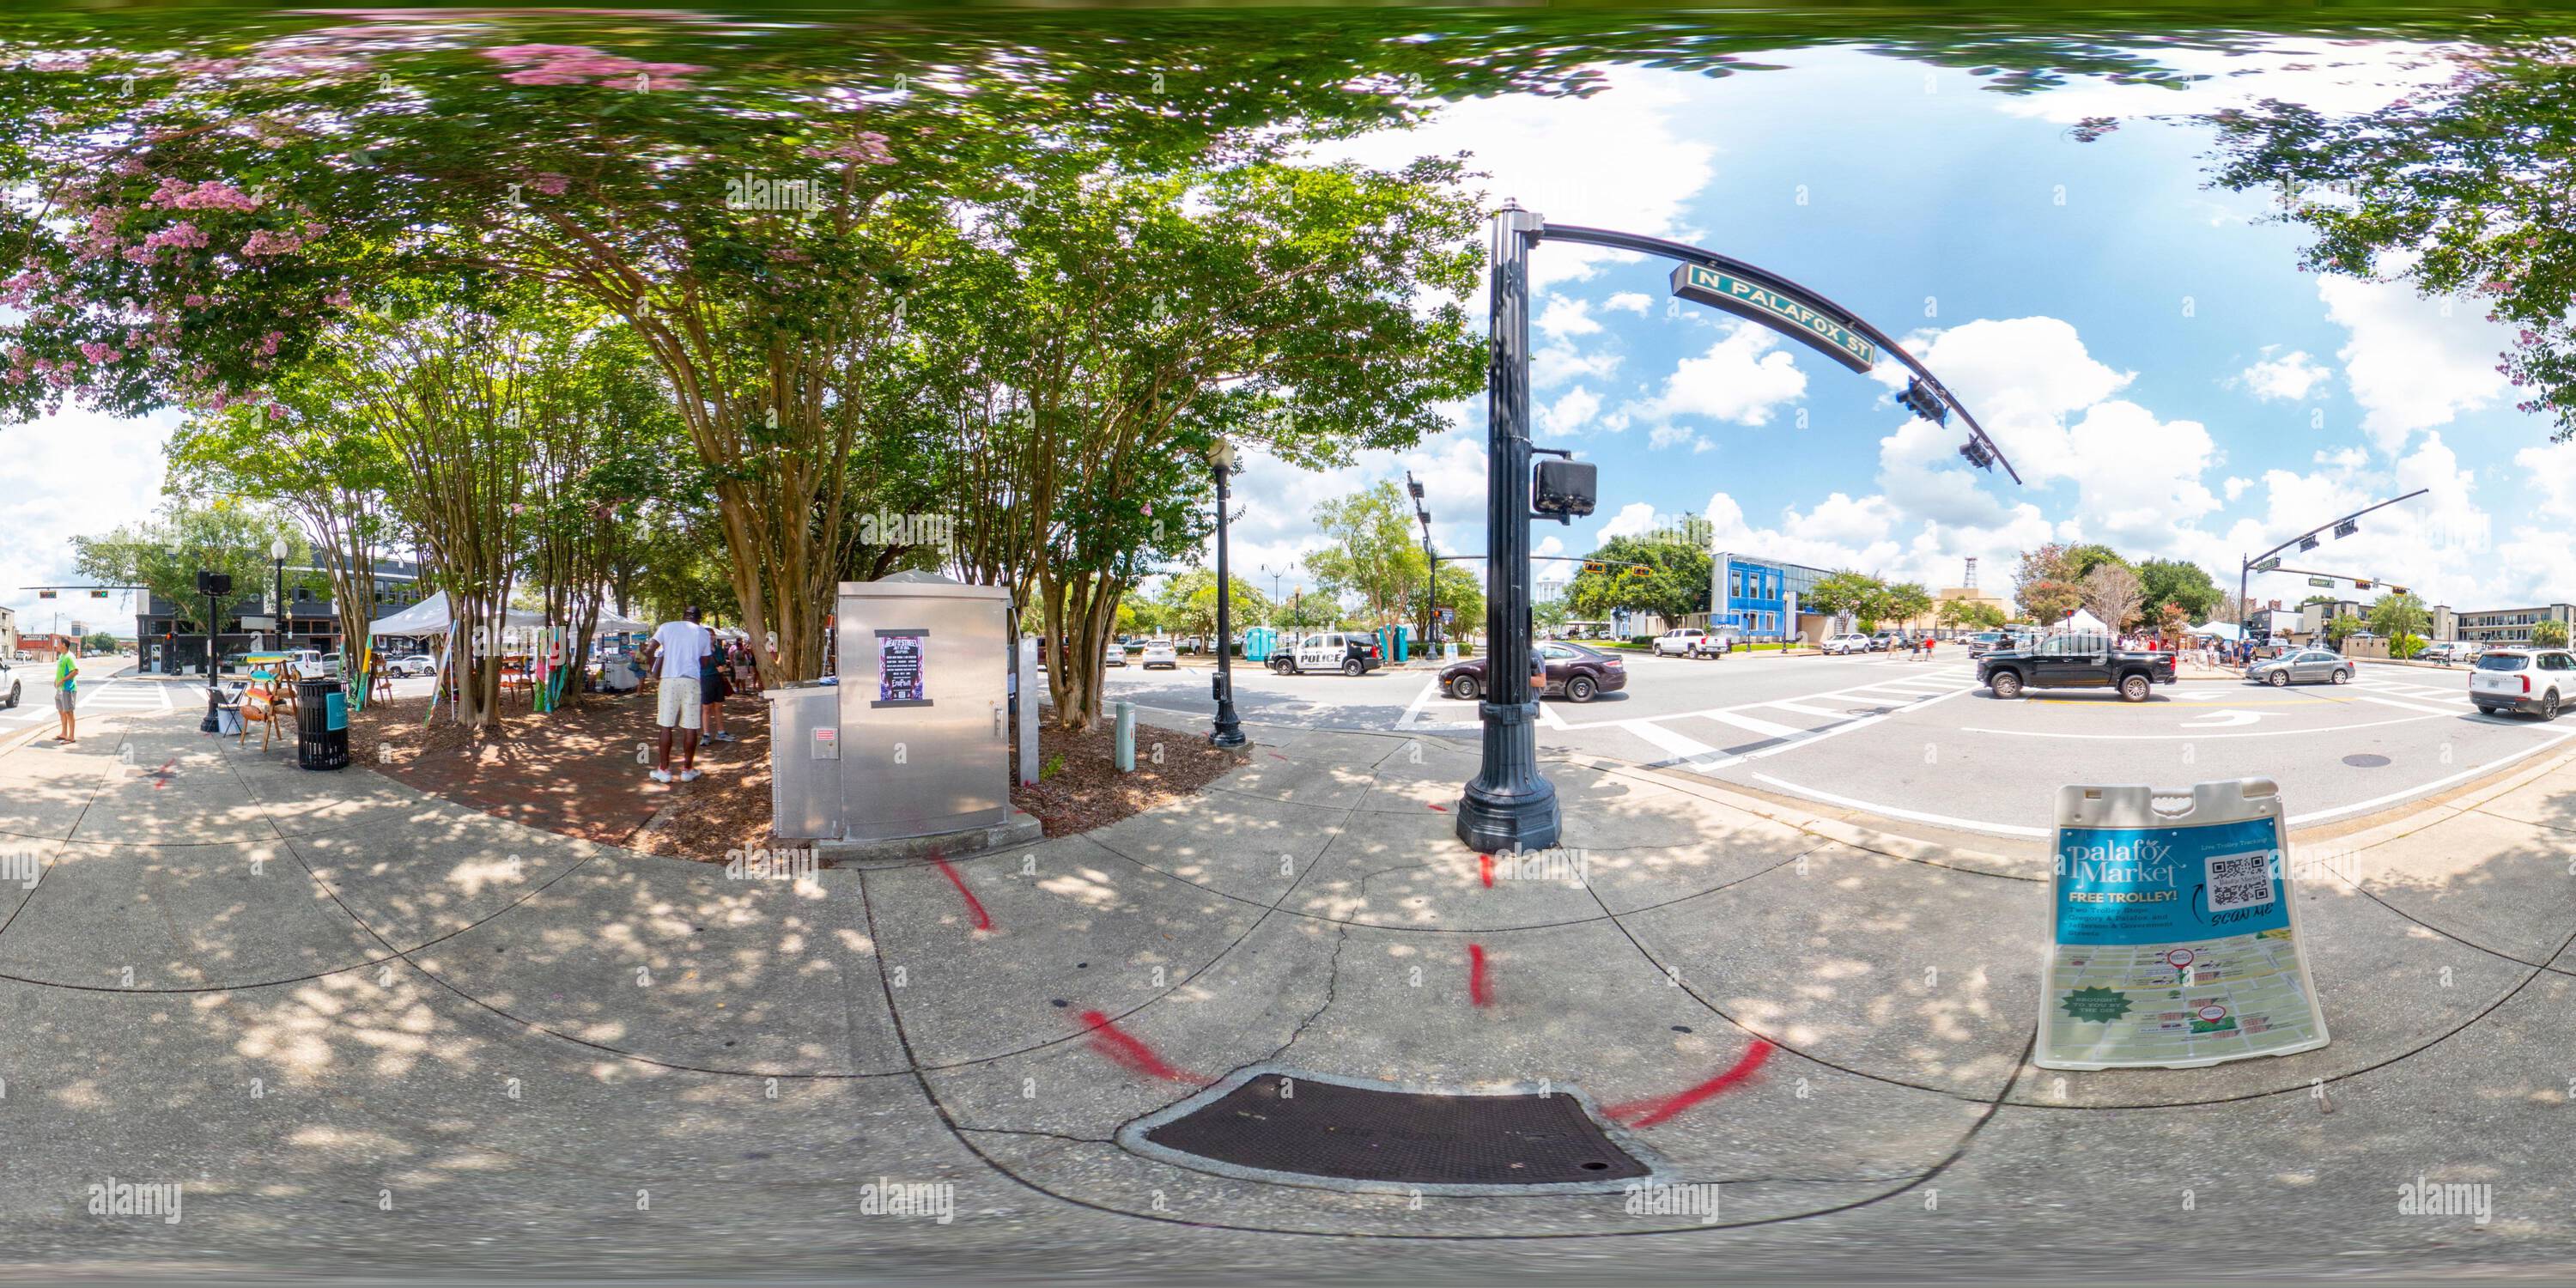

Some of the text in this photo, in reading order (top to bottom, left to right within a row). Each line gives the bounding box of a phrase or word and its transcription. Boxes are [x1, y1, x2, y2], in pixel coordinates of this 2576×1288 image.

[1698, 270, 1869, 357] N PALAFOX ST
[1300, 653, 1341, 663] POLICE
[2066, 839, 2186, 878] Palafox
[2076, 862, 2178, 889] Market
[2069, 890, 2178, 902] FREE TROLLEY!
[2212, 902, 2274, 927] SCAN ME
